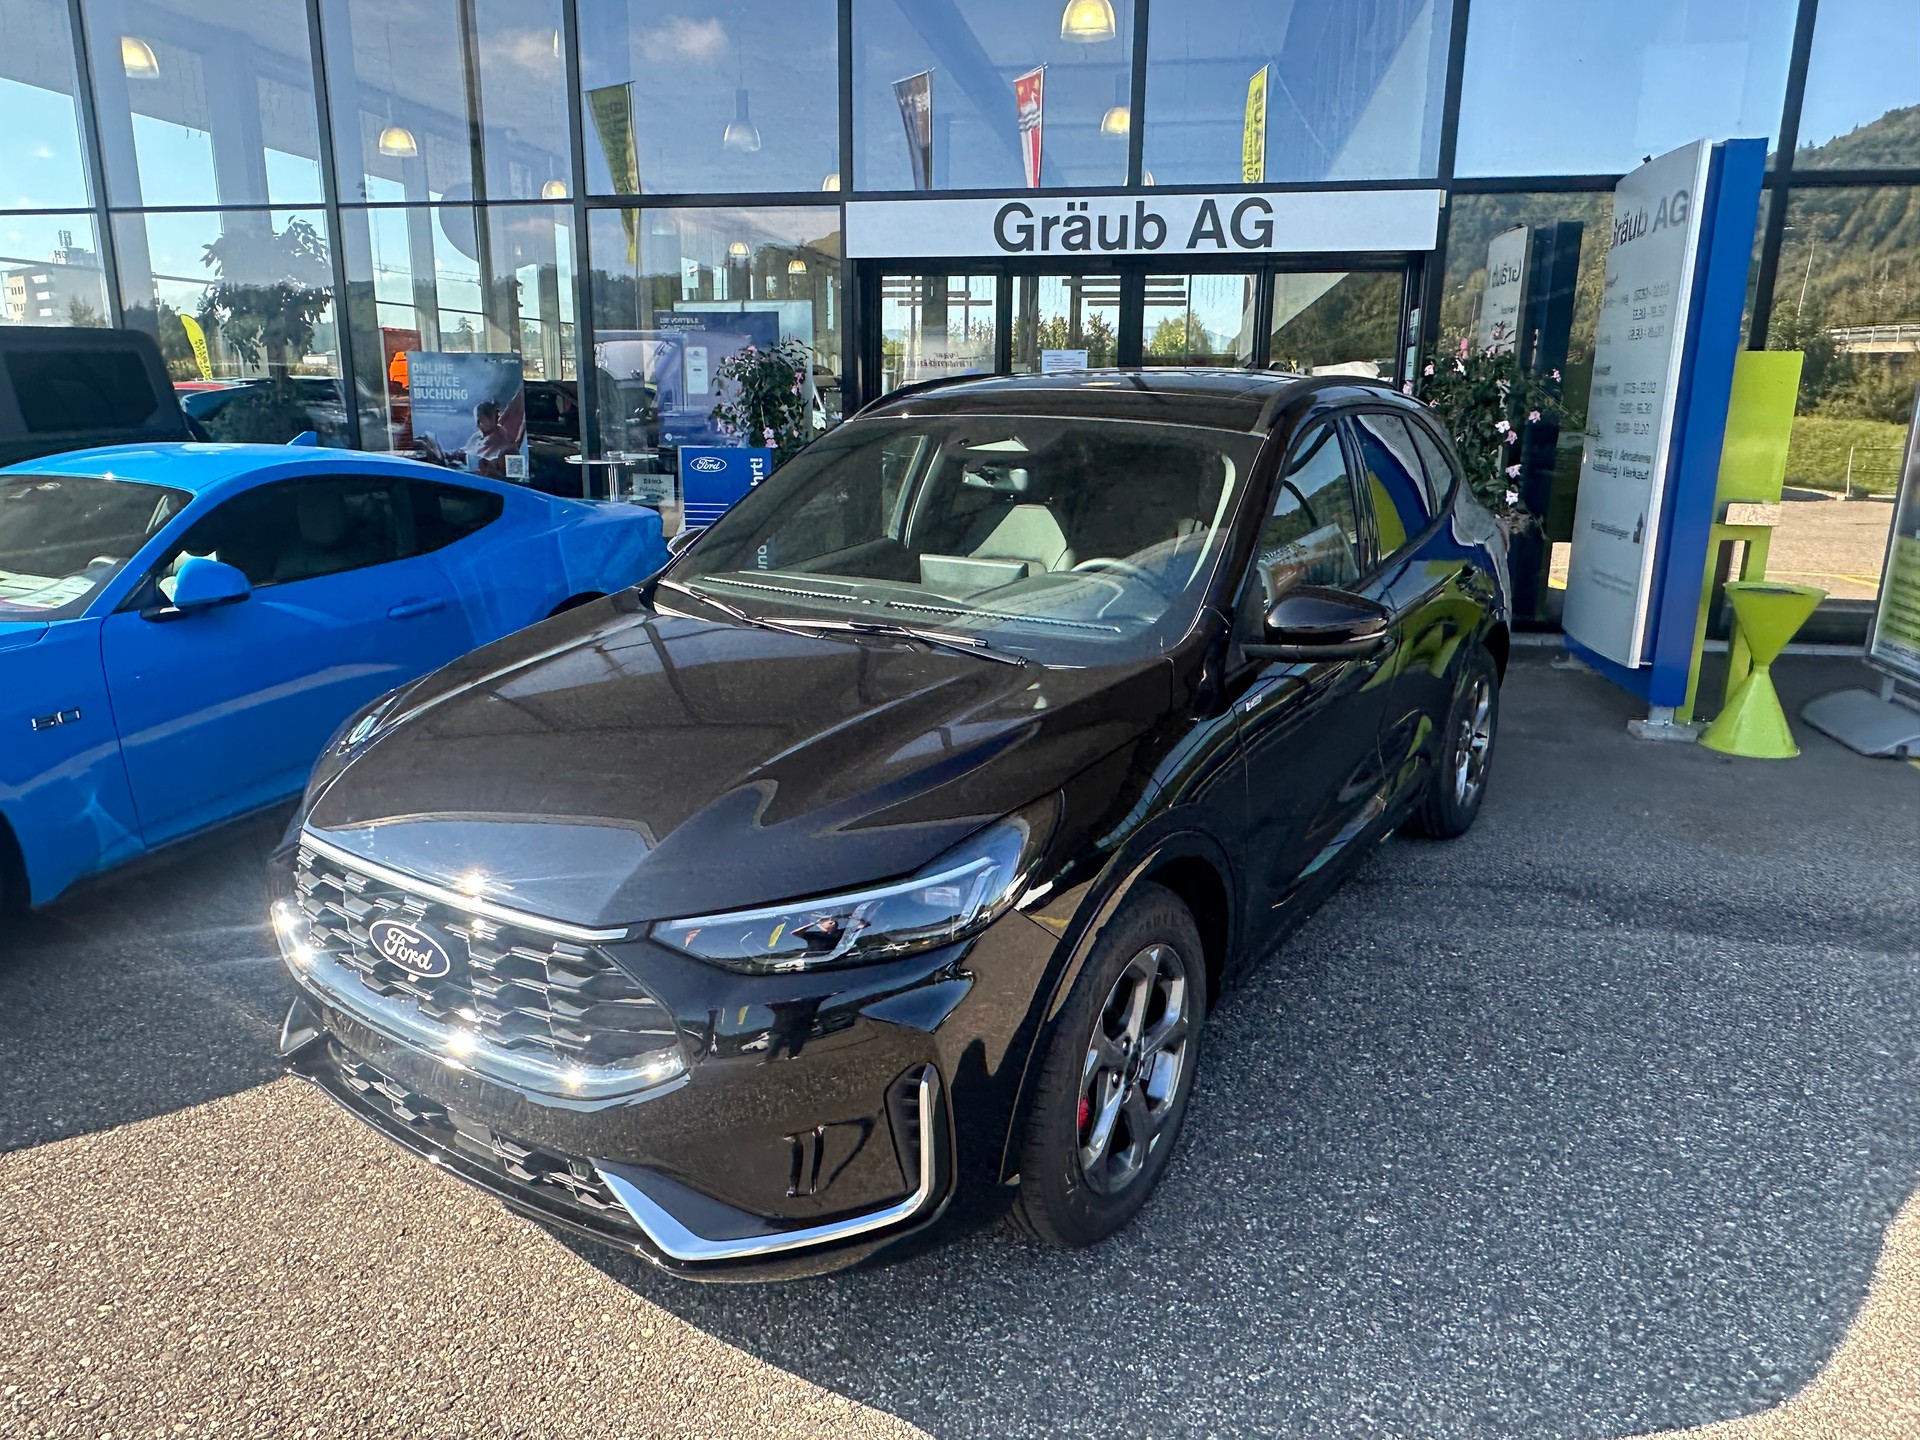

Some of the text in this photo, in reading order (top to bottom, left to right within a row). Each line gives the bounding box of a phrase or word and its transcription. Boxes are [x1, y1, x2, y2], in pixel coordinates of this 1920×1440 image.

[1652, 190, 1689, 233] AG
[994, 197, 1274, 252] Gräub AG
[412, 362, 454, 374] ONLINE
[413, 375, 460, 387] SERVICE
[414, 388, 468, 400] BUCHUNG
[31, 707, 81, 731] 5.0
[383, 927, 434, 971] Ford
